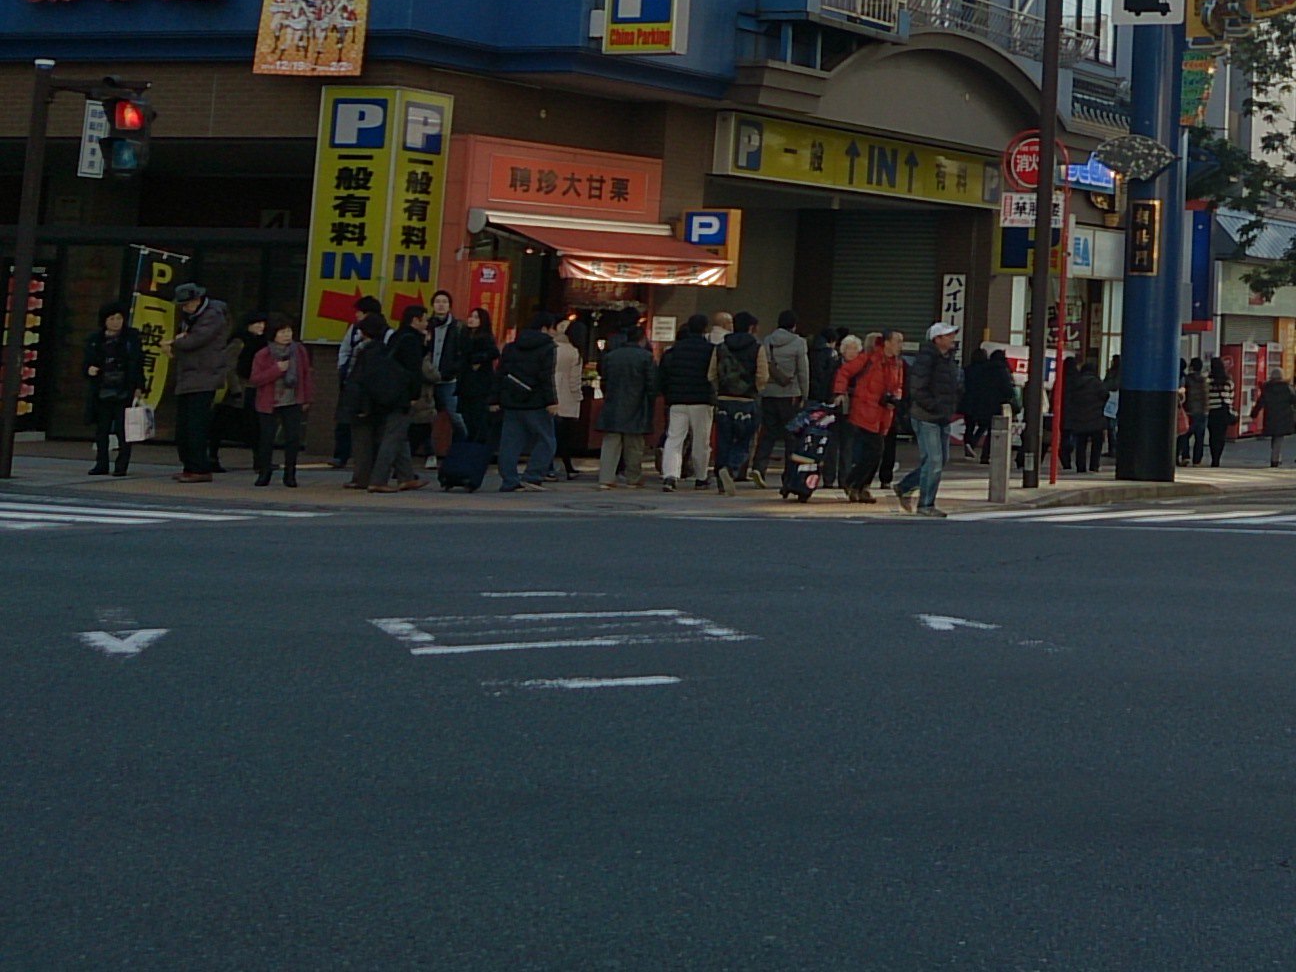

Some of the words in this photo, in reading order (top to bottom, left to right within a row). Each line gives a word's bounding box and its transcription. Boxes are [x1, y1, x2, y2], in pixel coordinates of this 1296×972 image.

[610, 28, 635, 46] China
[637, 27, 671, 47] Parking
[333, 102, 385, 145] P
[405, 106, 442, 149] P
[738, 122, 761, 168] P
[509, 165, 631, 203] 聘珍大甘栗
[867, 144, 898, 189] IN
[329, 154, 374, 247] 一般有料
[400, 158, 434, 250] 一般有料
[690, 215, 720, 243] P
[151, 262, 173, 291] P
[320, 251, 374, 281] IN
[392, 253, 431, 283] IN
